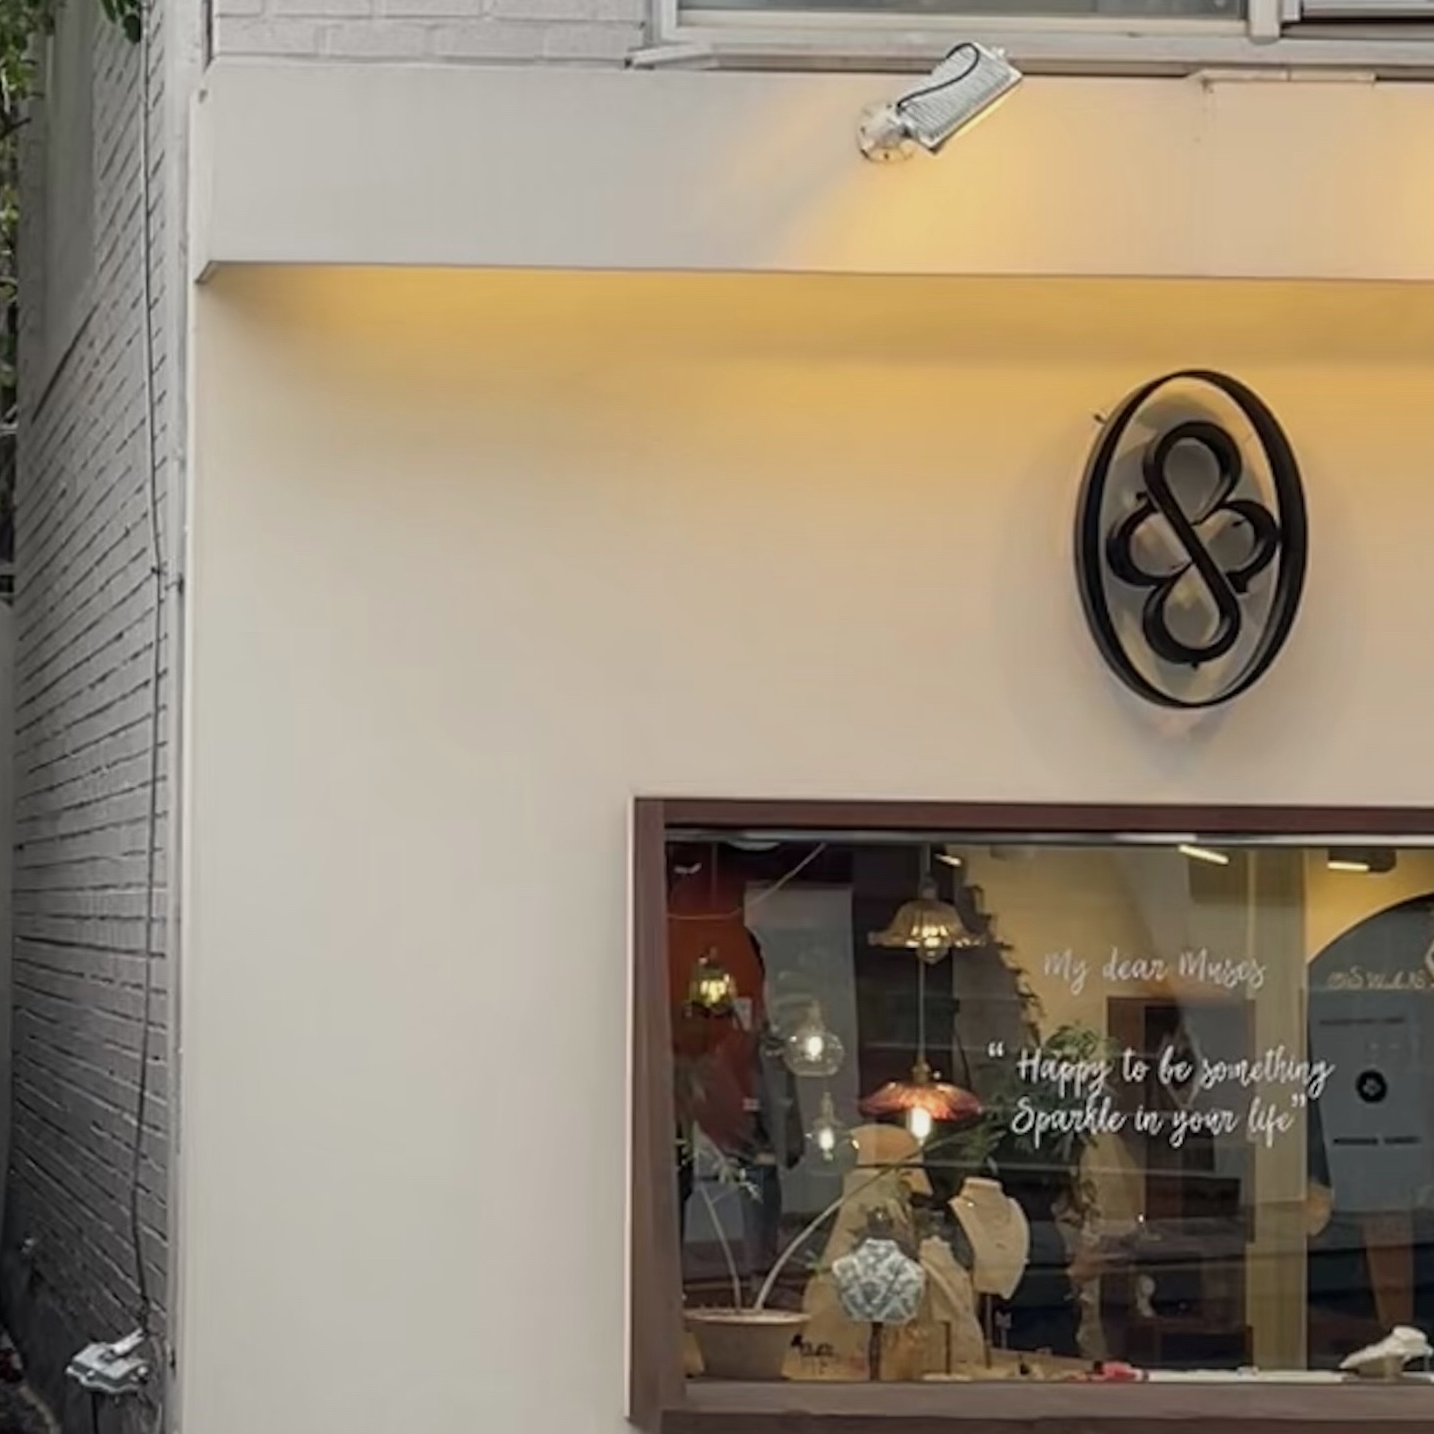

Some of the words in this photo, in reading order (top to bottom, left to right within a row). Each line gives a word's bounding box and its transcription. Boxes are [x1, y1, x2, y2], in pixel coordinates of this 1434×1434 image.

[1043, 947, 1087, 996] My
[1102, 946, 1167, 981] dear
[1179, 947, 1265, 989] Muses
[1122, 1047, 1150, 1082] to
[1157, 1045, 1193, 1085] be
[1199, 1045, 1336, 1099] something
[1011, 1094, 1127, 1149] Sparkle
[1134, 1104, 1163, 1135] in
[1169, 1109, 1240, 1148] your
